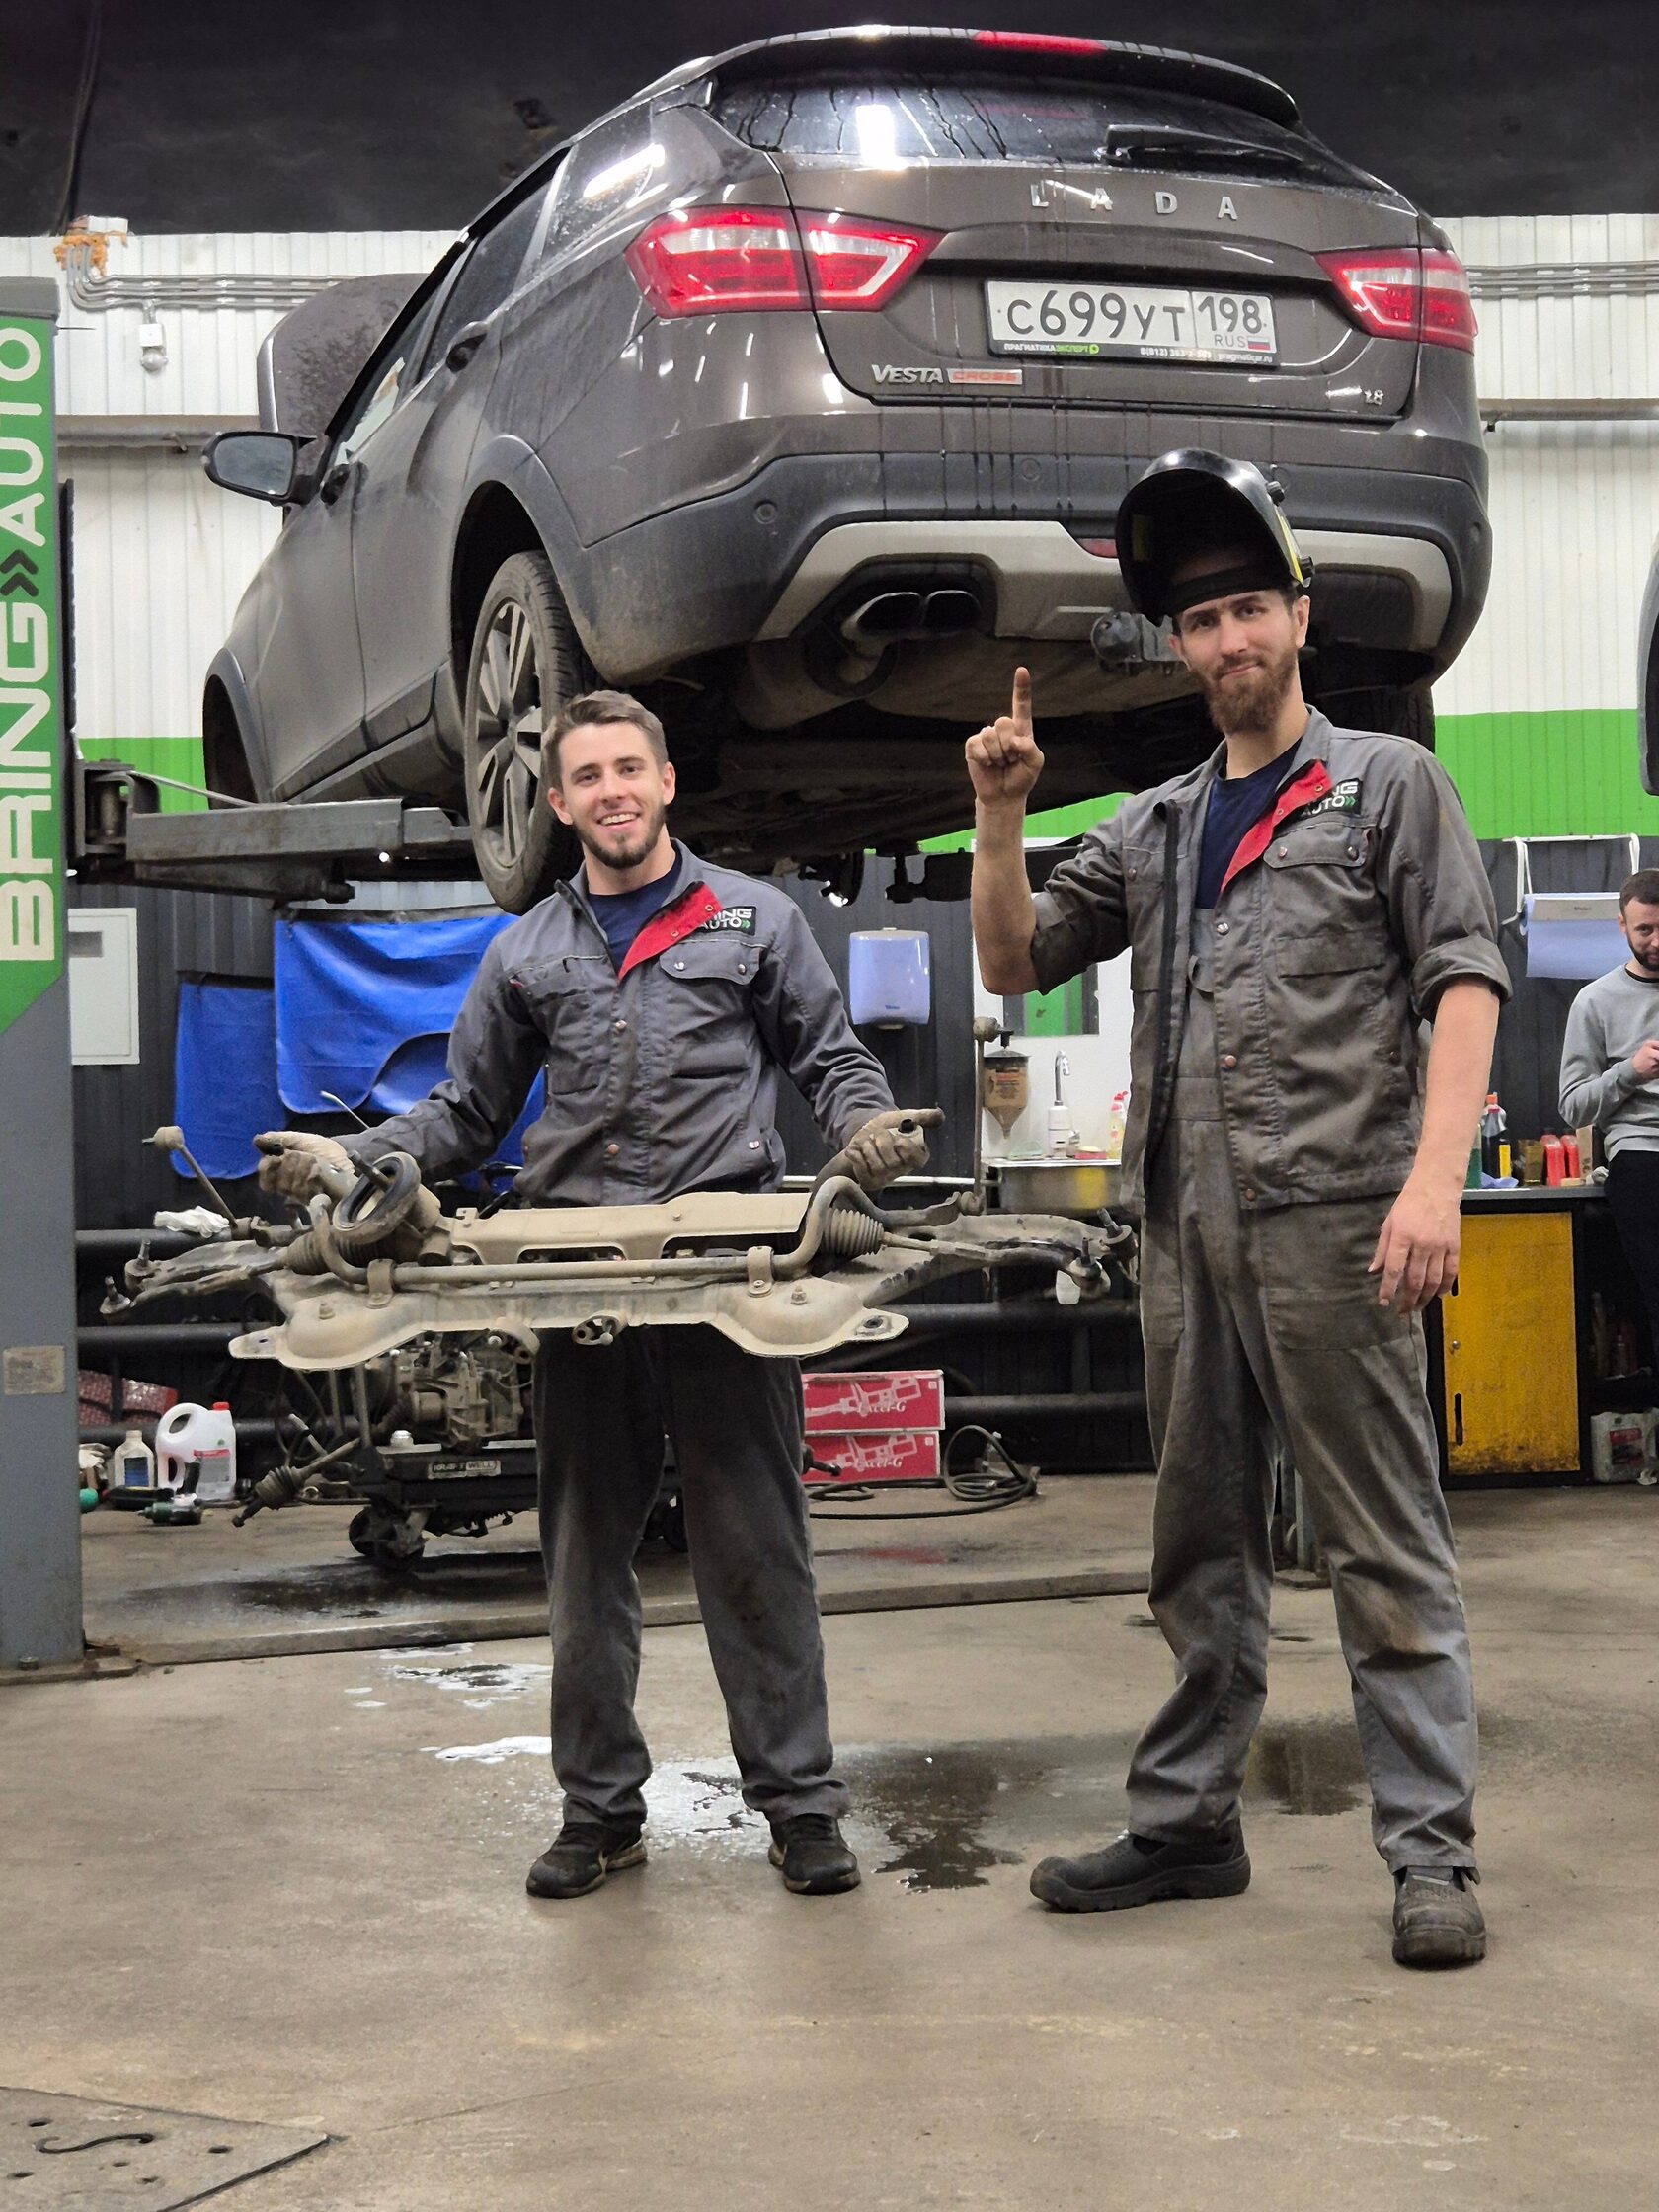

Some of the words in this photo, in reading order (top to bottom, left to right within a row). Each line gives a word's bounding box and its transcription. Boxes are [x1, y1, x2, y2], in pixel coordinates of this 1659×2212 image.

[1030, 184, 1238, 220] LADA
[1198, 296, 1262, 334] 198
[1215, 334, 1246, 348] RUS
[871, 364, 944, 384] VESTA
[952, 371, 1018, 382] CROSS
[0, 602, 55, 961] BRING
